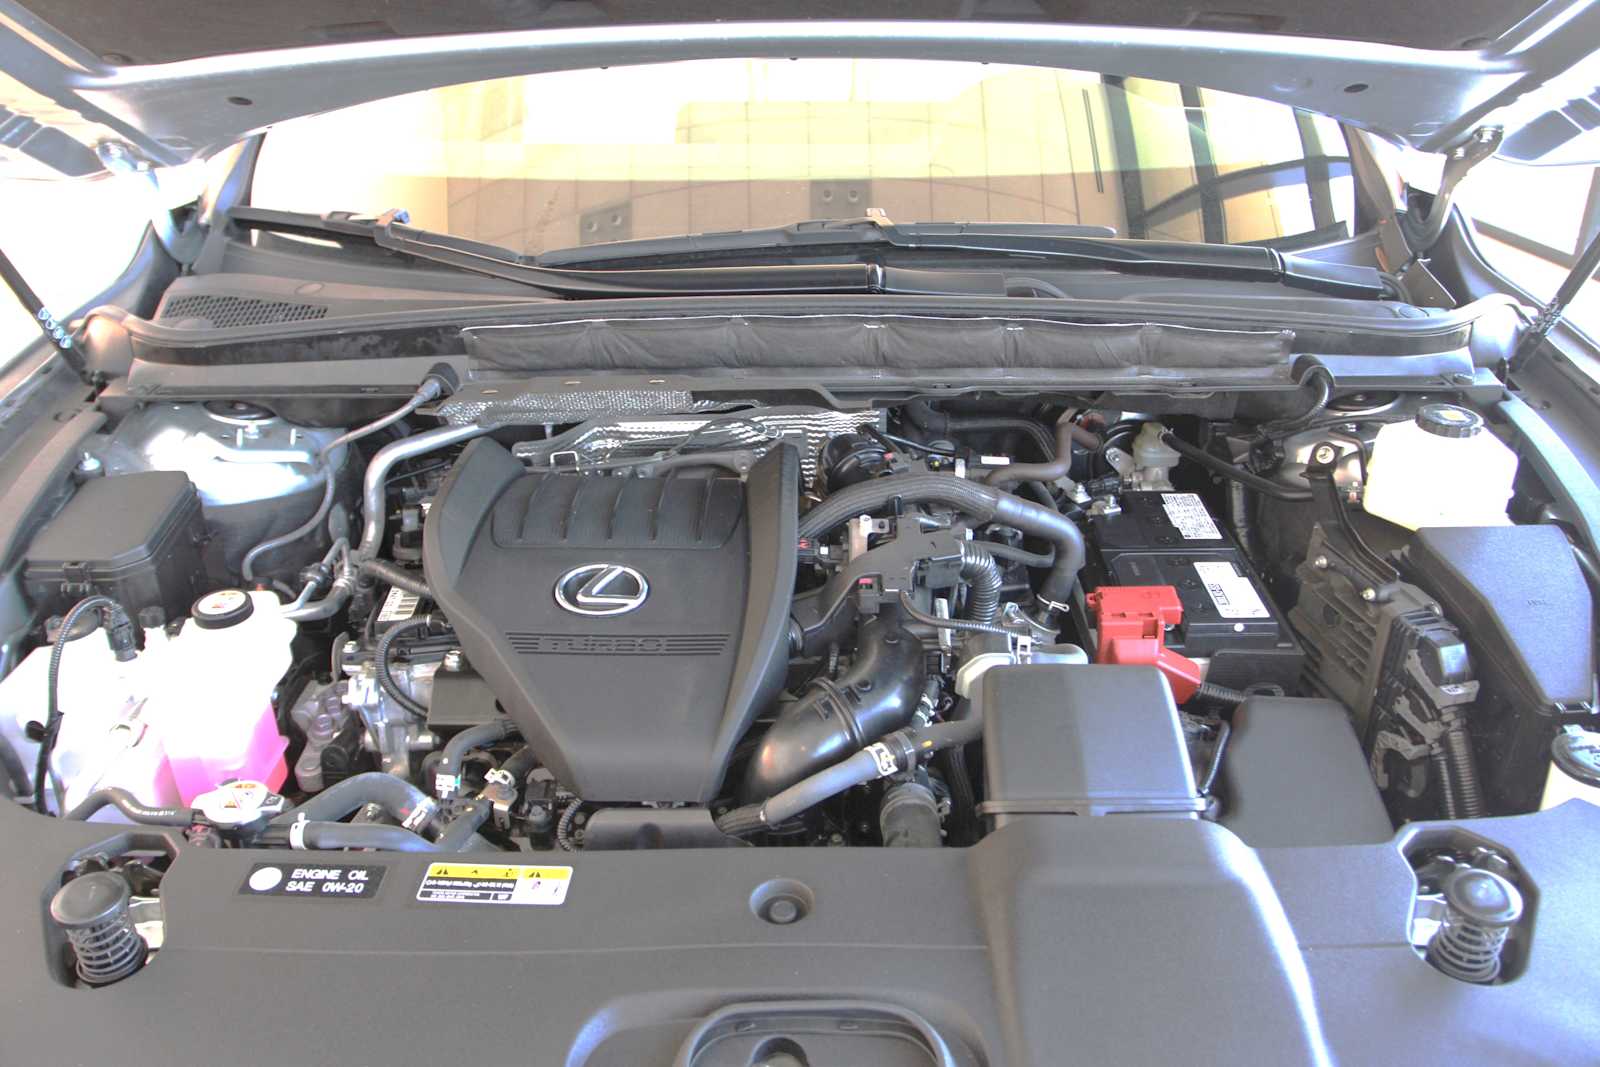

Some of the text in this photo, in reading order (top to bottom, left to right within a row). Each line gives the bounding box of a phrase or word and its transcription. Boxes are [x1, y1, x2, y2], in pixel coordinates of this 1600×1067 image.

[542, 636, 663, 653] TURBO
[291, 868, 369, 881] ENGINE OIL
[285, 880, 365, 893] SAE 0W-20
